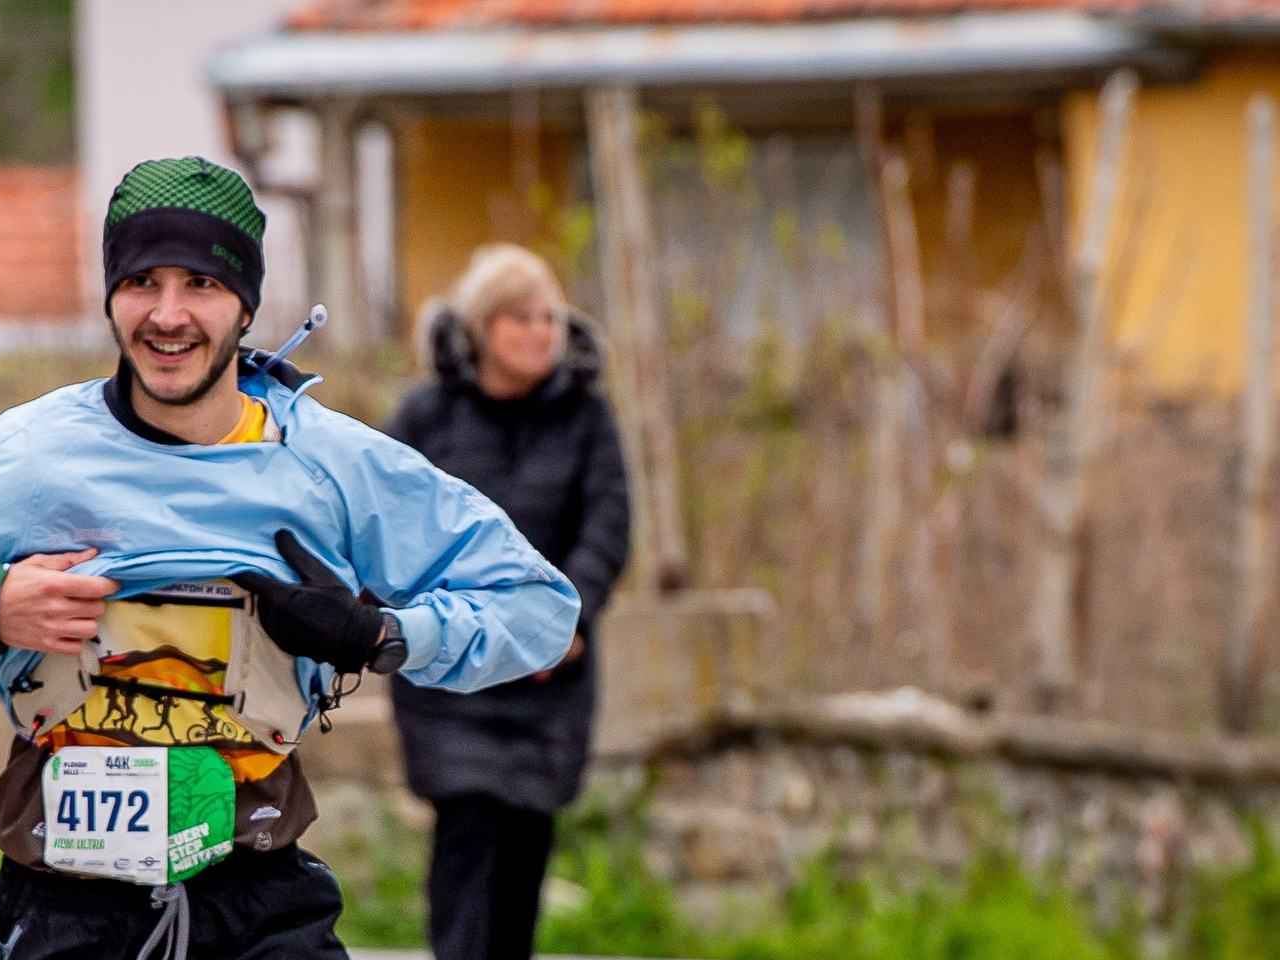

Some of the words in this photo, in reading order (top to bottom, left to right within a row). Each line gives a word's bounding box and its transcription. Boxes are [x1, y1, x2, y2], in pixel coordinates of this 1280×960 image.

[105, 755, 130, 770] 44K
[57, 790, 150, 832] 4172
[76, 838, 106, 850] ULTRA
[168, 822, 210, 848] EVERY
[169, 838, 204, 862] STEP
